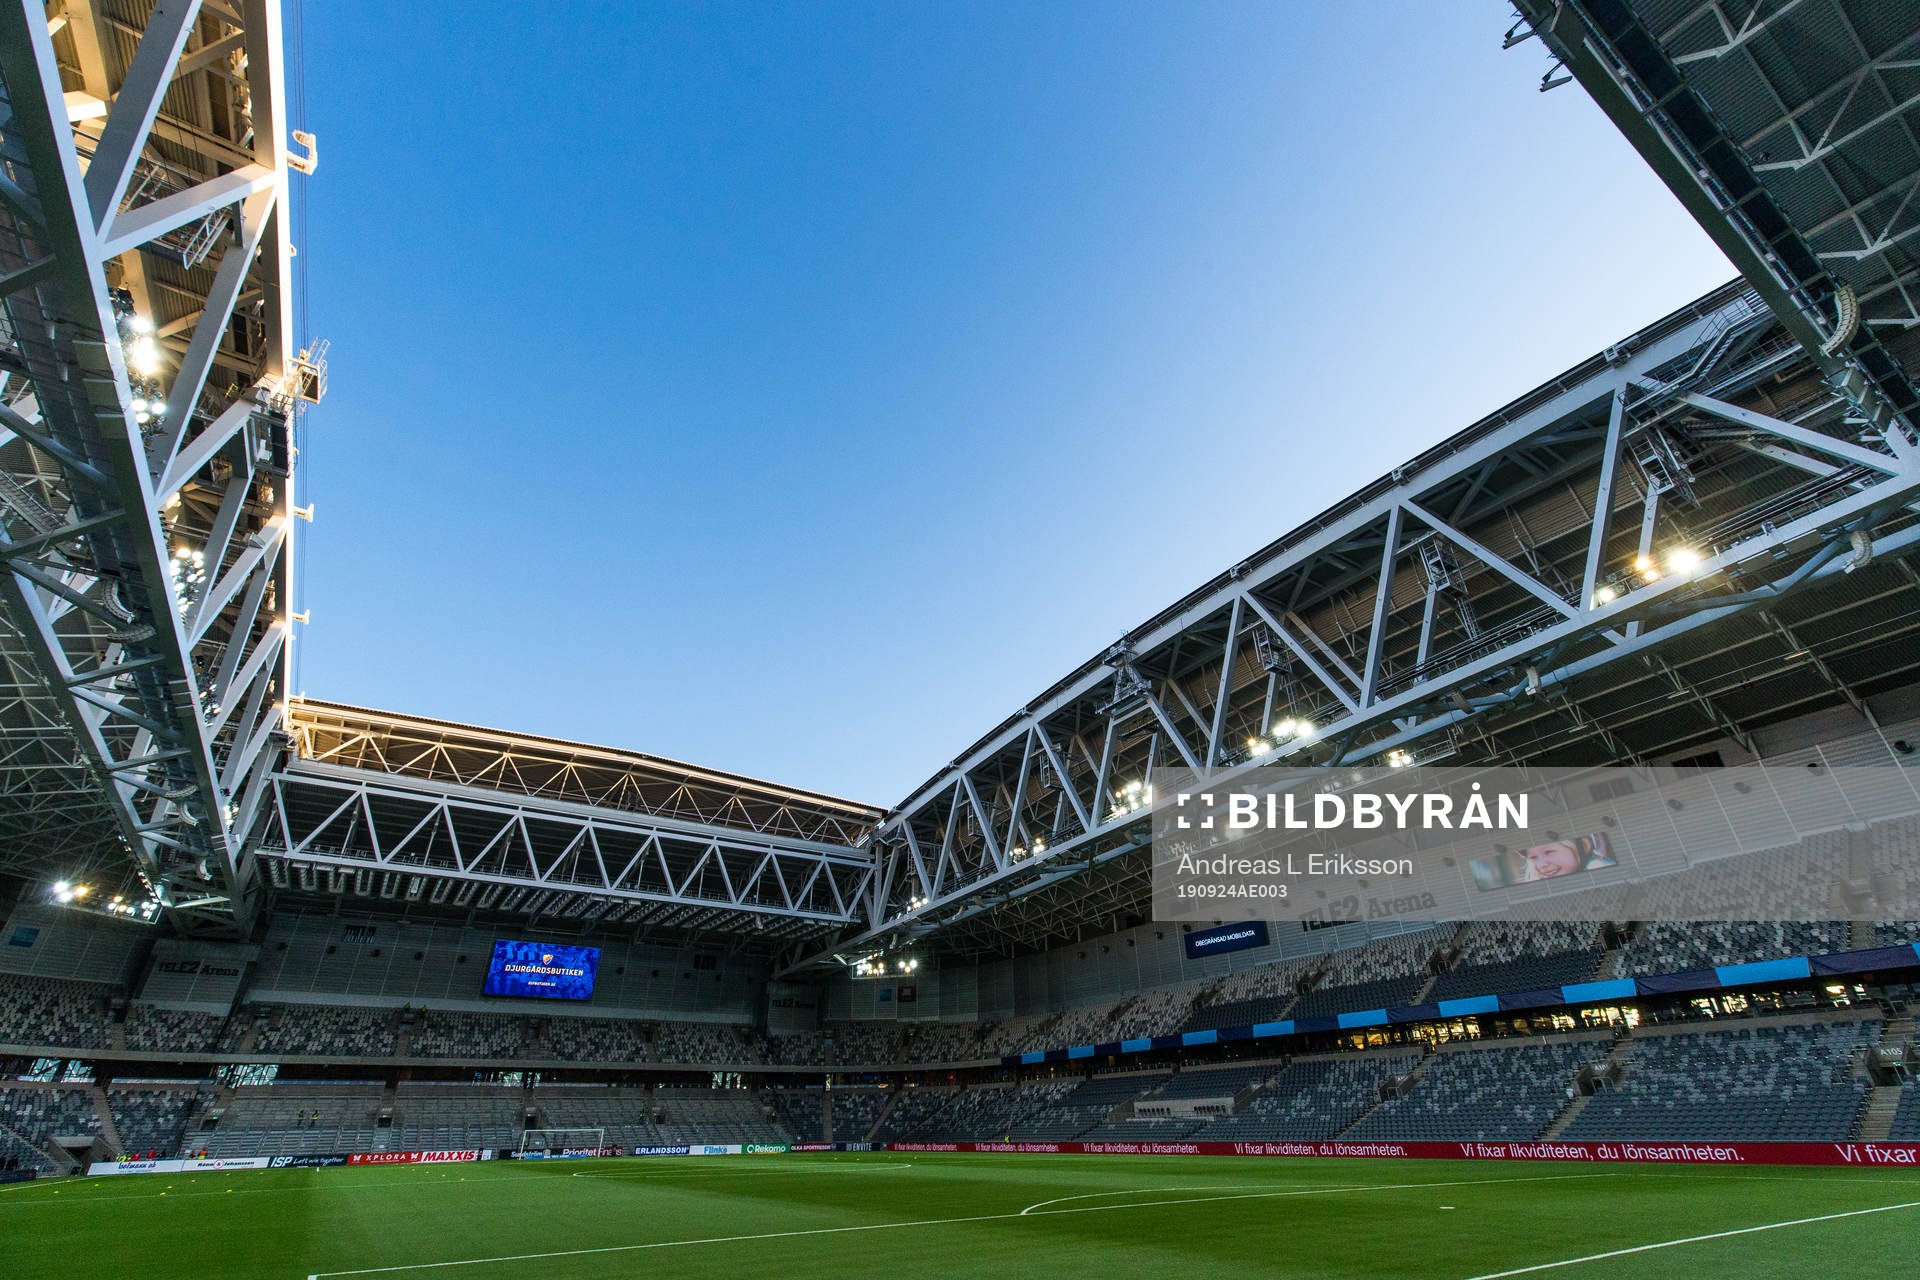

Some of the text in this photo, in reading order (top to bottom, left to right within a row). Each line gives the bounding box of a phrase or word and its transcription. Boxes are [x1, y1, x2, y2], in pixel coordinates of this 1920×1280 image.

[1298, 892, 1438, 932] TELE2 Arena
[1195, 930, 1256, 947] OBEGRÄNSAD MOBILDATA
[200, 964, 239, 977] Arena
[504, 964, 584, 977] DJURGÅRDSBUTIKEN
[1880, 1048, 1903, 1056] A105
[562, 1148, 597, 1157] Prioritet
[635, 1146, 688, 1155] ERLANDSSON
[755, 1144, 786, 1153] Rekomo
[992, 1143, 1016, 1152] likviditeten,
[1025, 1143, 1060, 1152] lönsamheten.
[1083, 1143, 1200, 1154] Vi fixar likviditeten, du lönsamheten.
[1234, 1143, 1408, 1157] Vi fixar likviditeten, du lönsamheten.
[1460, 1143, 1743, 1161] Vi fixar likviditeten, du lönsamheten.
[366, 1153, 406, 1161] XPLORA
[424, 1151, 475, 1161] MAXXIS
[1836, 1144, 1917, 1163] Vi fixar
[270, 1156, 293, 1168] ISP
